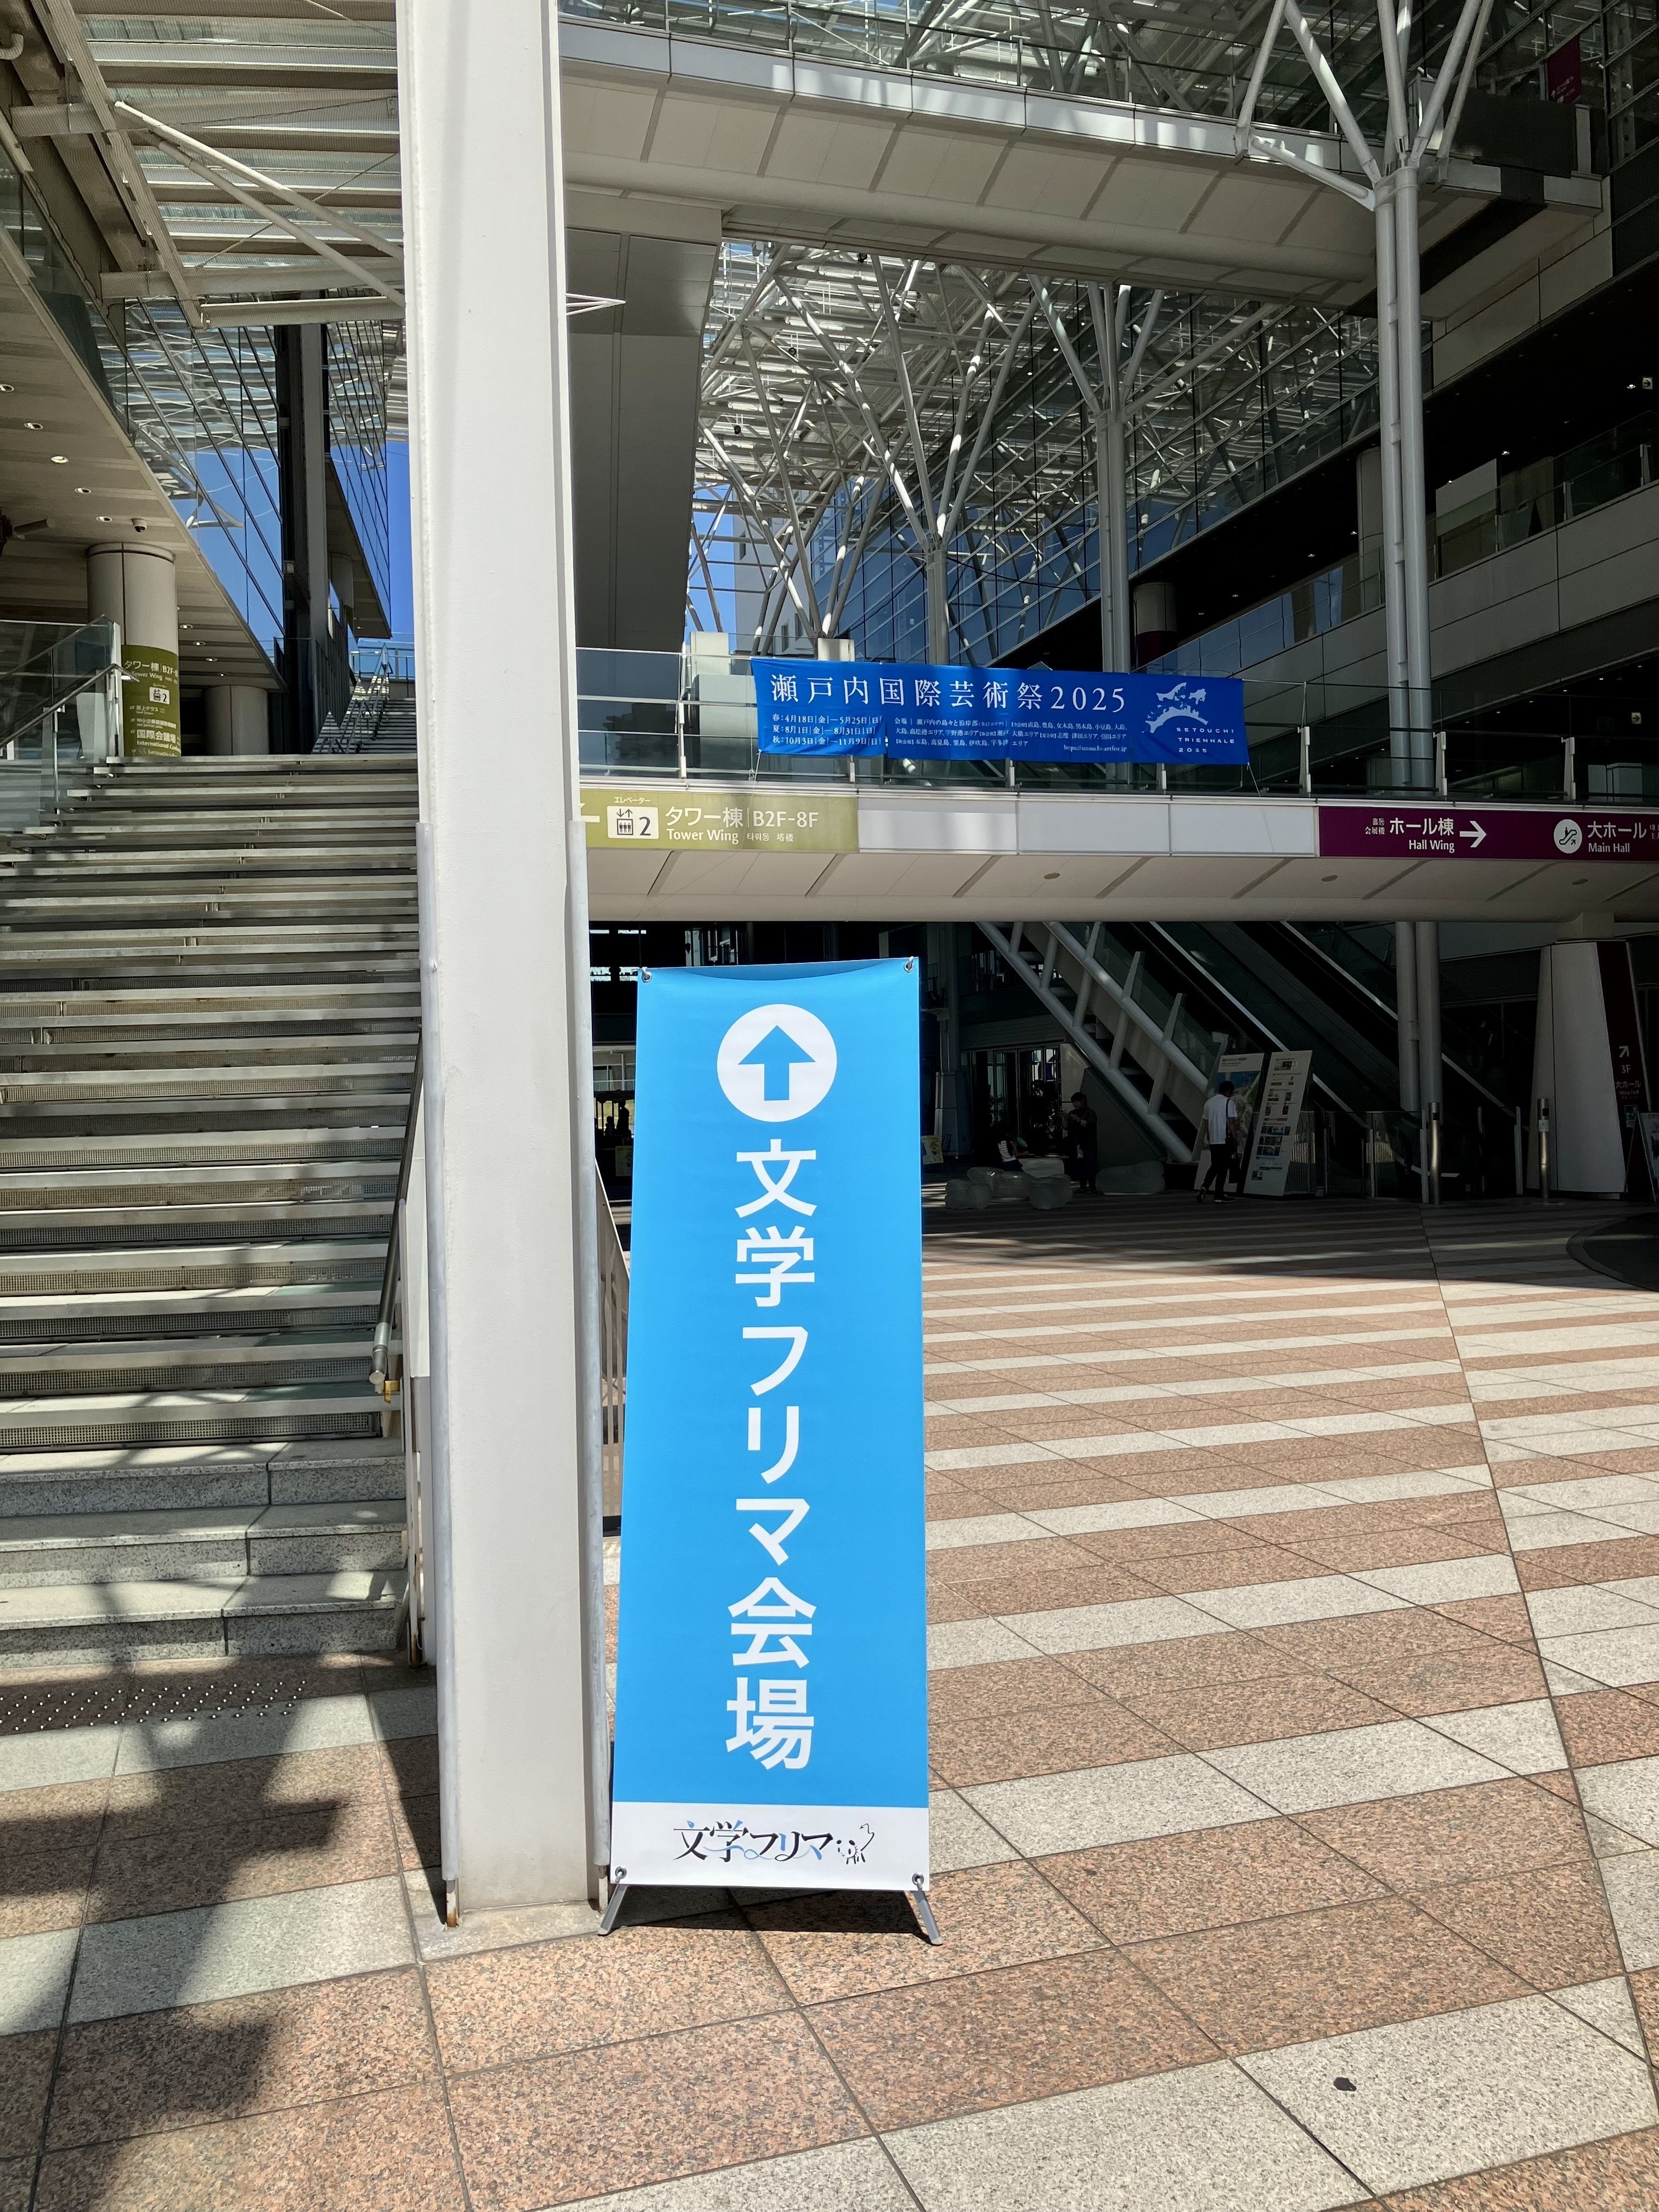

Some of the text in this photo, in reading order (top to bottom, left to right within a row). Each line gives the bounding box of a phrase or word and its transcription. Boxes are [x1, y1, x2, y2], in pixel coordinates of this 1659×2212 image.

[162, 693, 167, 702] 2
[770, 674, 1125, 713] 瀬戸内国際芸術祭2025
[639, 816, 651, 836] 2
[665, 806, 819, 828] タワー棟 B2F-8F
[1390, 817, 1454, 836] ホール棟
[1587, 821, 1647, 839] 大ホール
[666, 828, 740, 845] Tower Wing
[747, 832, 770, 842] 타워동
[1409, 839, 1455, 853] Hall Wing
[1588, 842, 1630, 853] Main Hall
[1621, 1064, 1631, 1074] 3F
[725, 1138, 818, 1770] 文学フリマ会場
[673, 1820, 833, 1863] 文学フリマ
